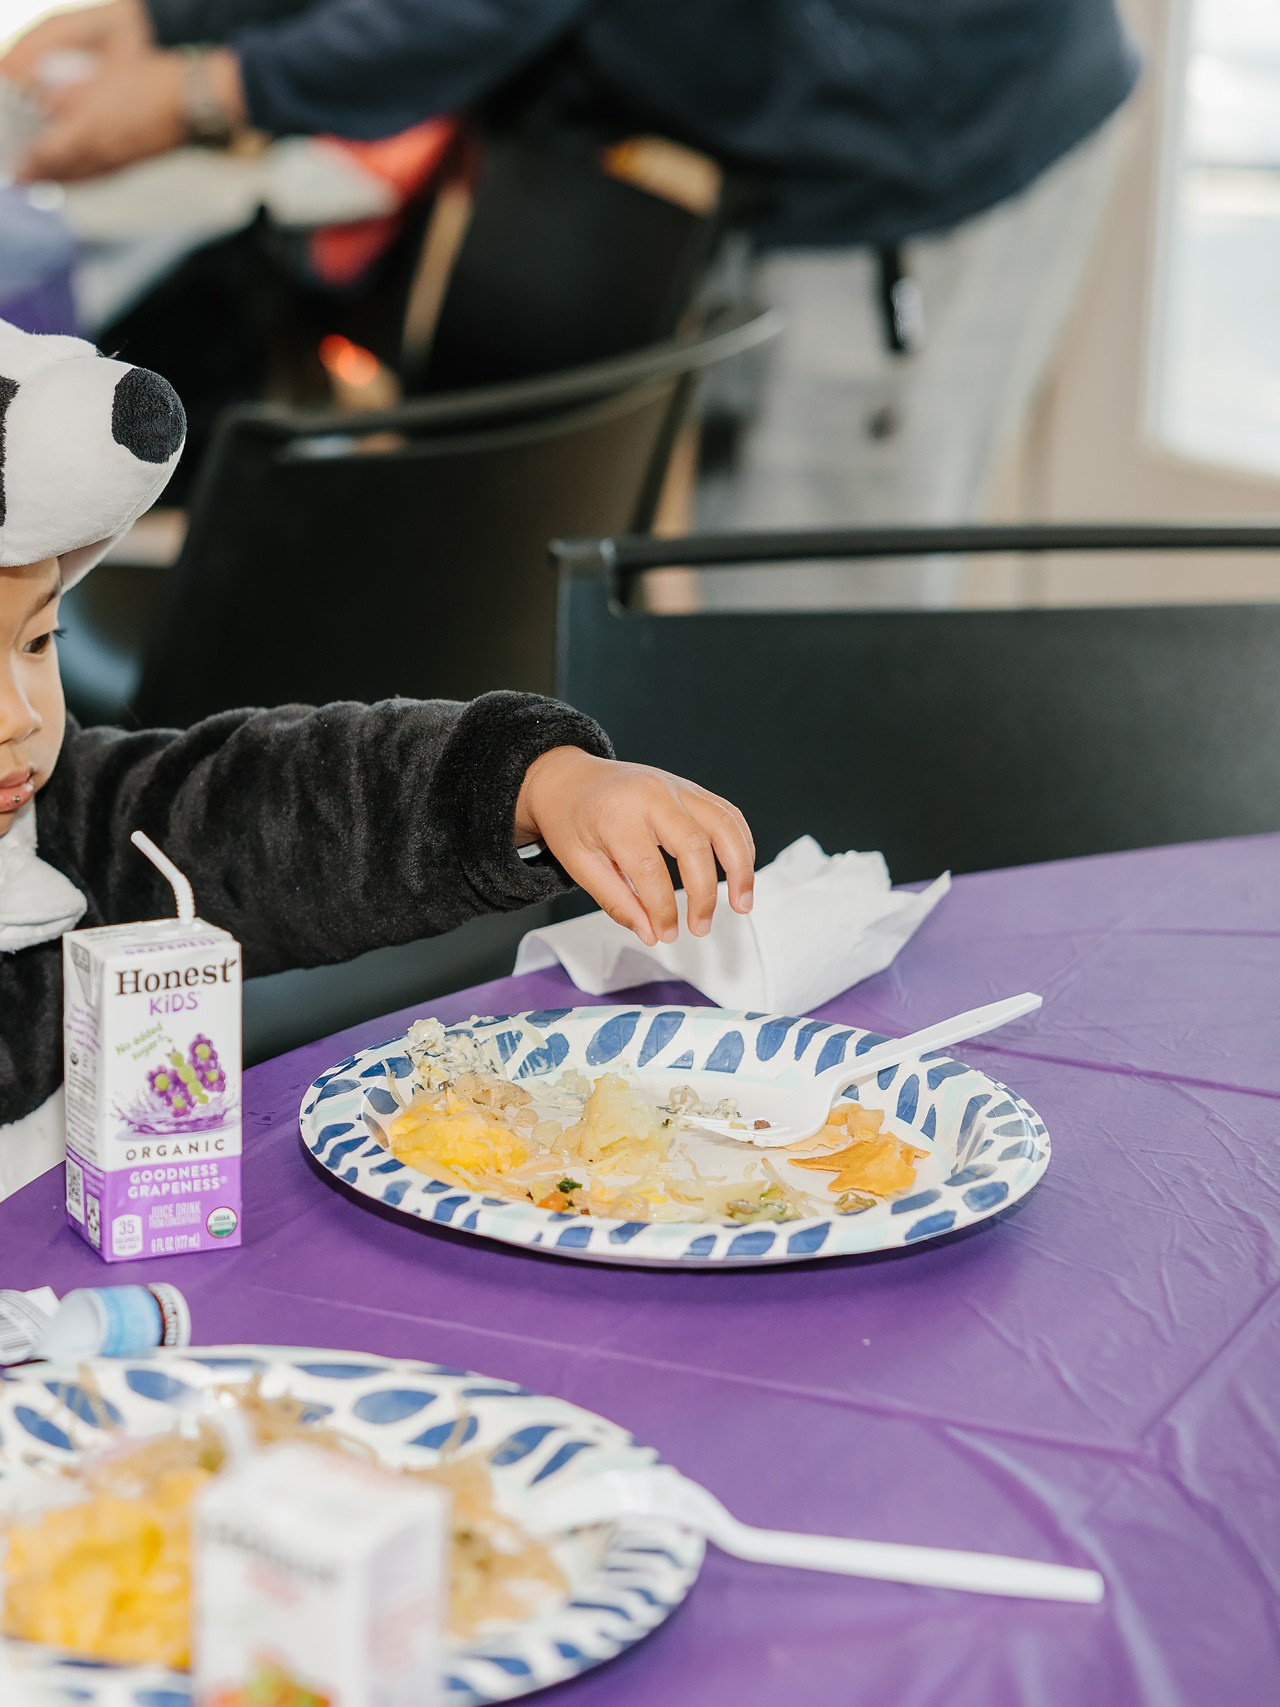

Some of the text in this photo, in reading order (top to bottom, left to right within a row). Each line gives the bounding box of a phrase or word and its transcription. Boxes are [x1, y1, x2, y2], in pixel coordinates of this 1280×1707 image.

[115, 957, 237, 996] Honest
[150, 991, 198, 1015] KiDS
[126, 1139, 225, 1161] ORGANIC
[130, 1163, 218, 1185] GOODNESS
[127, 1178, 220, 1199] GRAPENESS
[175, 1201, 201, 1216] DRINK
[119, 1220, 135, 1235] 35
